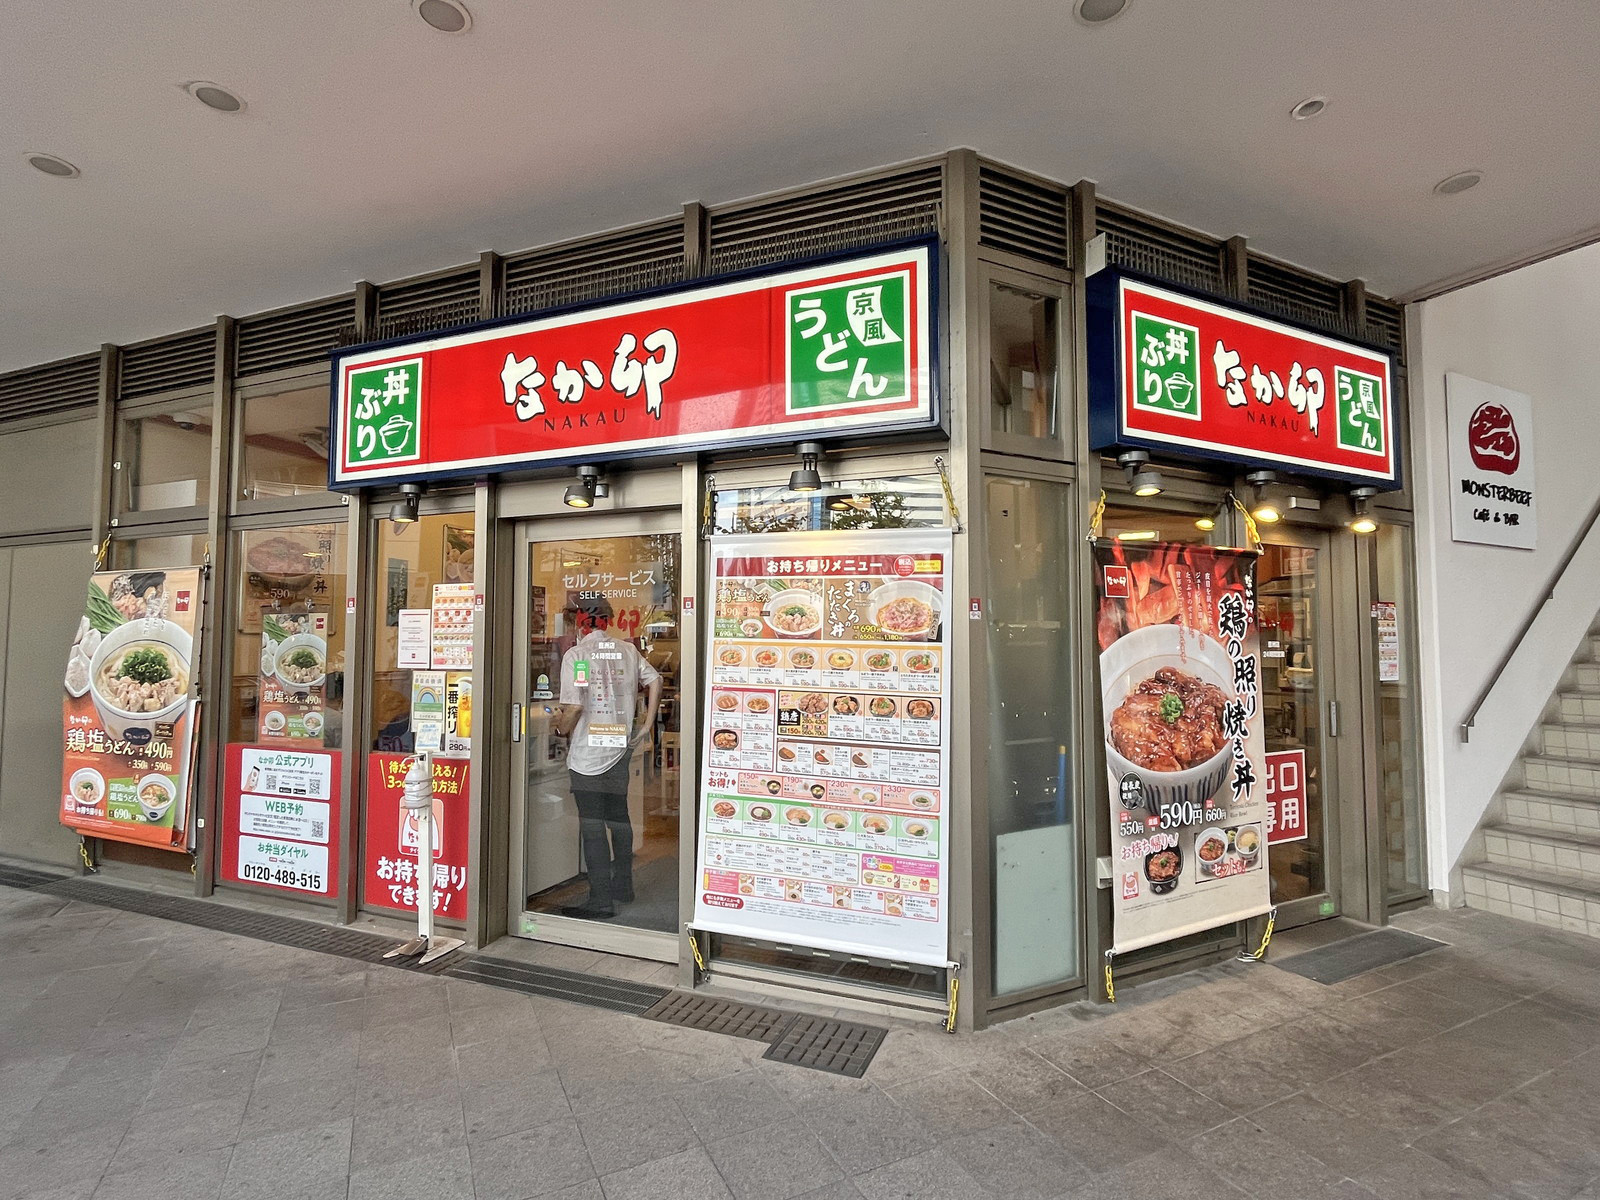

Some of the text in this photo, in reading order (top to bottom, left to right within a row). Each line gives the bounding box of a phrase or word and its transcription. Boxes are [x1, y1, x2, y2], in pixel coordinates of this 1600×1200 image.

[853, 290, 886, 341] 京風
[792, 298, 889, 400] うどん
[500, 327, 679, 419] なか卯
[1213, 339, 1325, 436] なか卯
[543, 408, 627, 432] NAKAU
[1247, 411, 1300, 432] NAKAU
[1339, 374, 1377, 449] うどん
[1461, 479, 1533, 507] MONSTERBEEF
[1503, 513, 1520, 526] BAR
[766, 557, 883, 574] お持ち帰りメニュー
[562, 570, 656, 589] セルフサービス
[579, 588, 637, 600] SELF SERVICE
[448, 683, 459, 734] 一番搾り
[1219, 593, 1257, 801] 鶏の照り焼き丼
[66, 728, 135, 756] 鶏塩うどん
[144, 741, 174, 759] 490円
[275, 754, 314, 769] 公式アプリ
[265, 800, 304, 816] WEB予約
[1160, 800, 1203, 829] 590円
[1205, 807, 1227, 822] 660円
[1120, 821, 1144, 836] 550円
[257, 842, 309, 859] お弁当ダイヤル
[1120, 832, 1180, 860] お持ち帰りも!
[244, 864, 321, 889] 0120-489-515
[1211, 858, 1248, 879] セットも!
